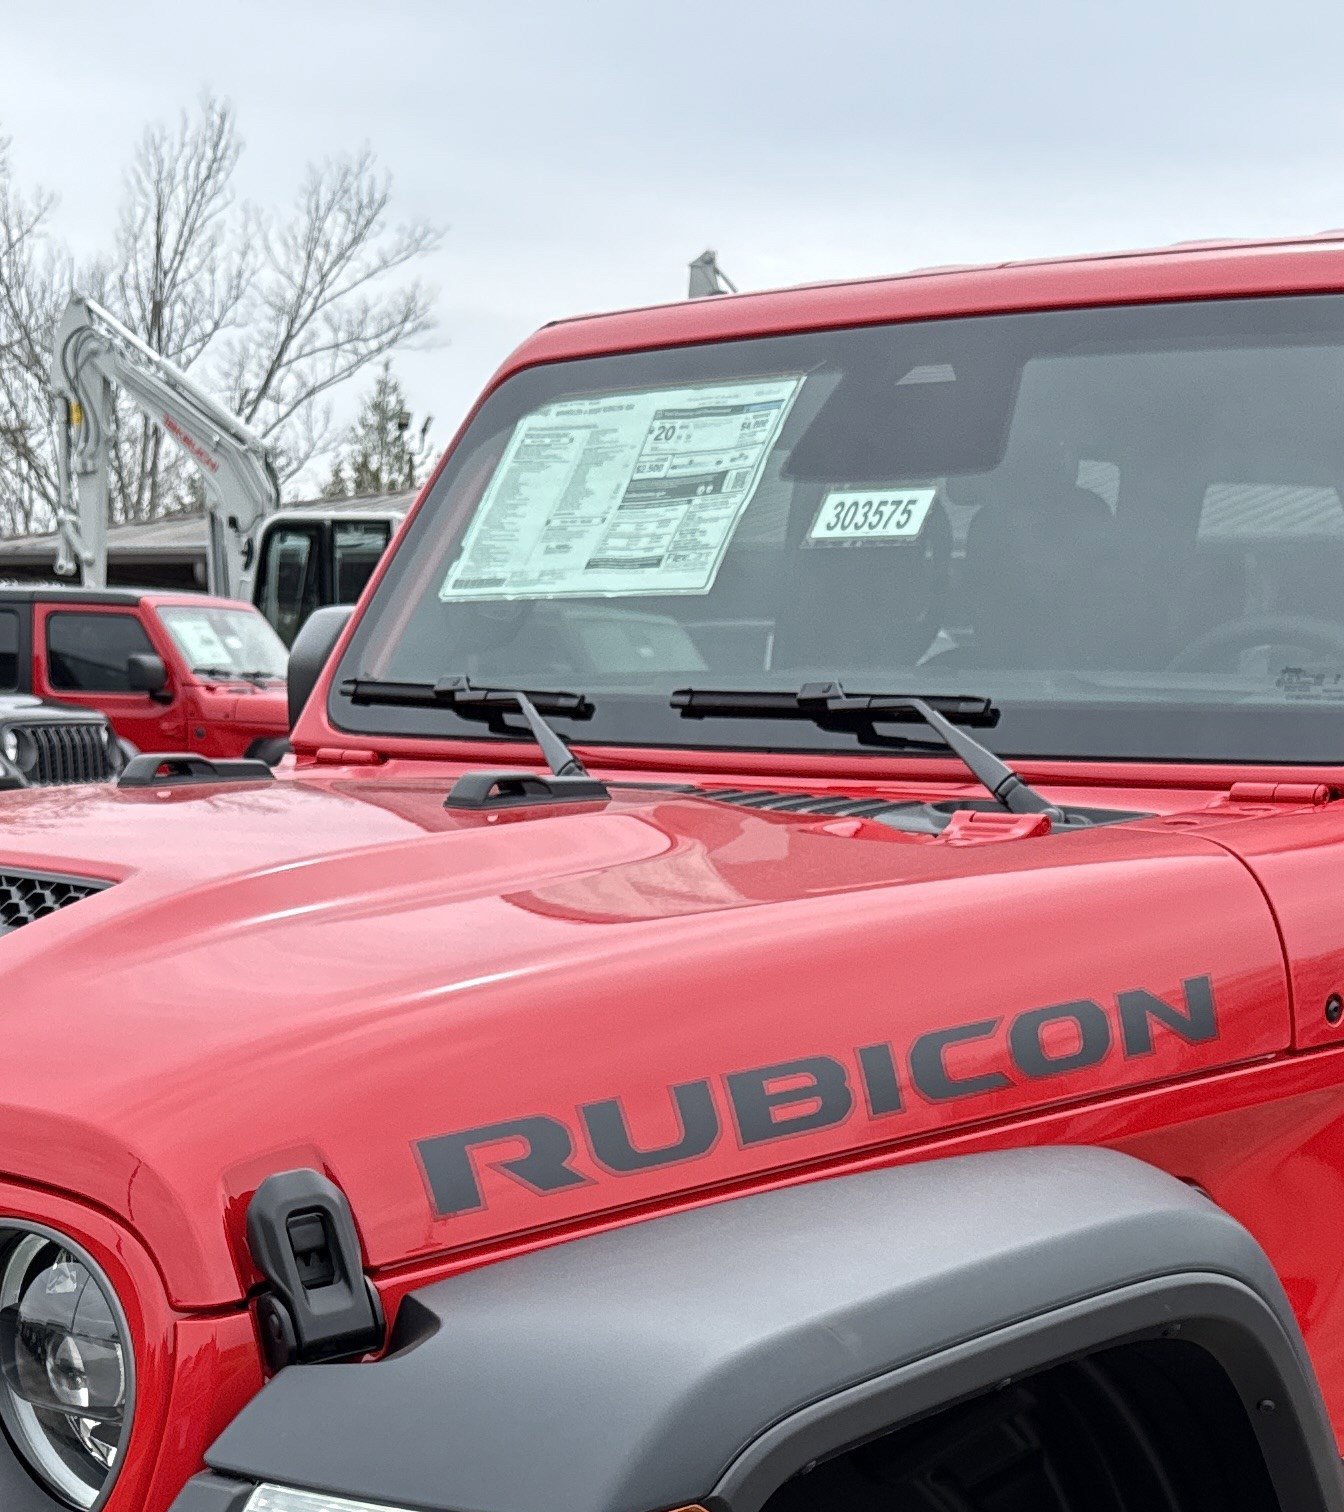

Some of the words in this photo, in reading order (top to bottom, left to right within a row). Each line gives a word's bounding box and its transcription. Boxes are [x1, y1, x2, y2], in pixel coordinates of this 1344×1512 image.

[654, 425, 677, 442] 20
[826, 500, 919, 531] 303575
[411, 973, 1220, 1220] RUBICON
